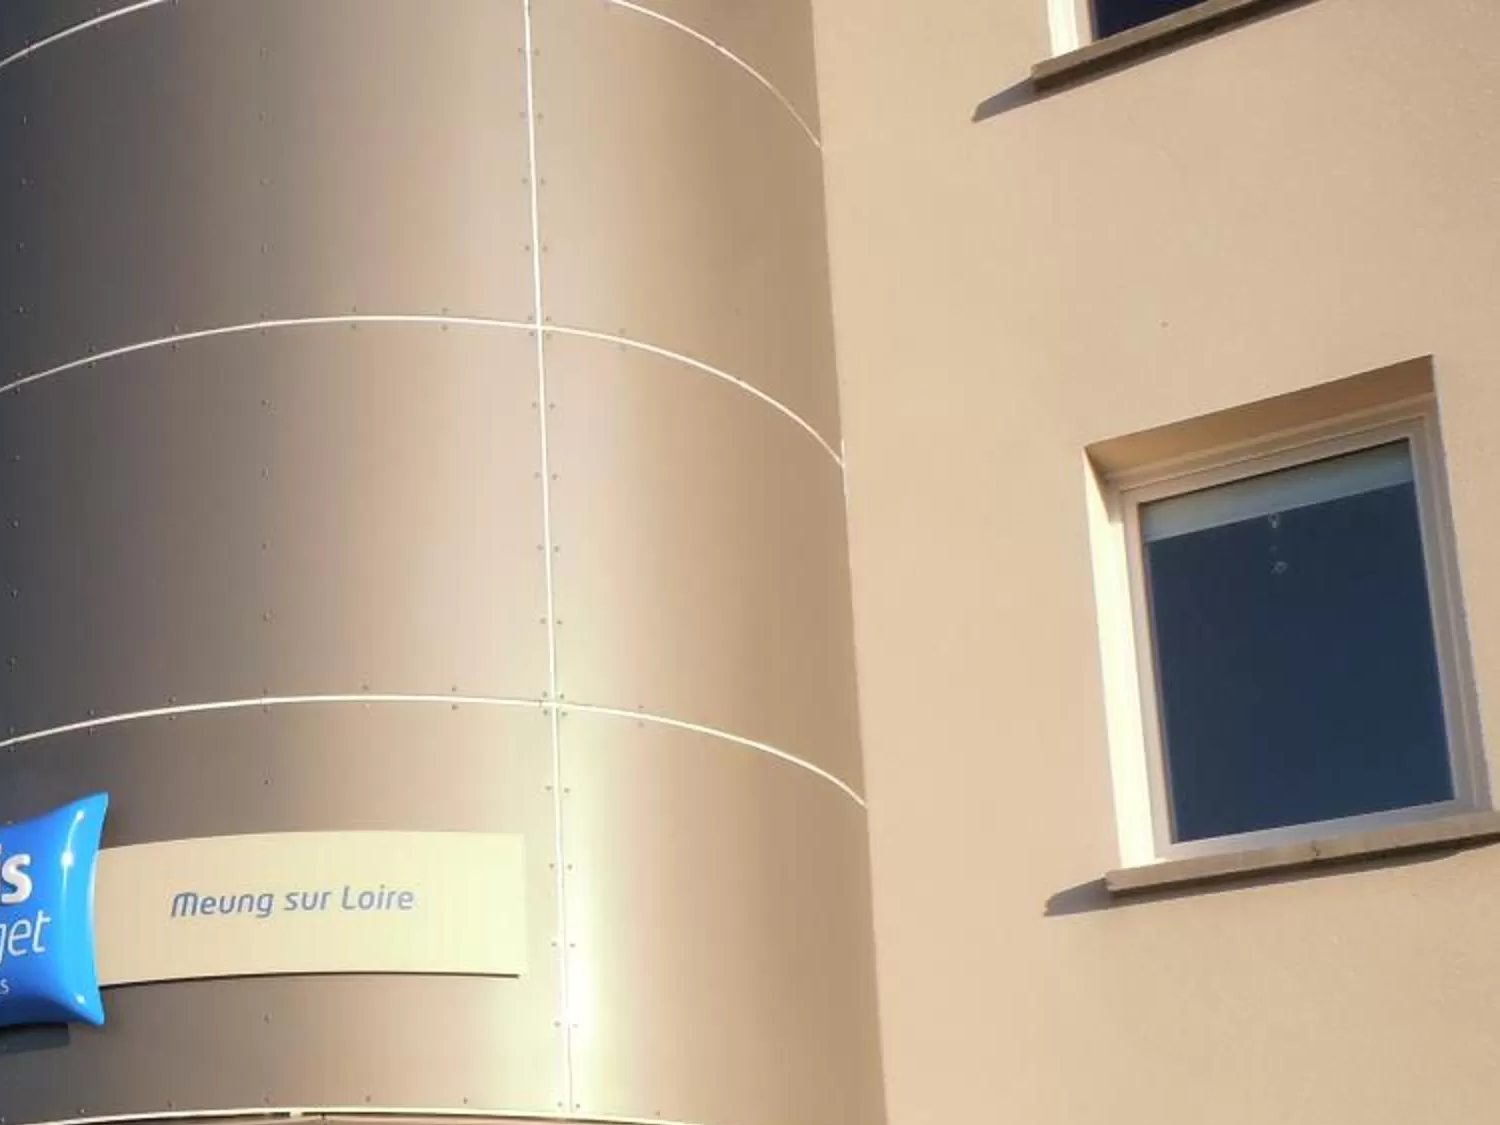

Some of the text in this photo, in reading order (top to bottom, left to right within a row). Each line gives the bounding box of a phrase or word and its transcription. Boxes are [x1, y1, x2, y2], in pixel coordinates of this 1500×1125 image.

[170, 885, 414, 918] Meung sur Loire
